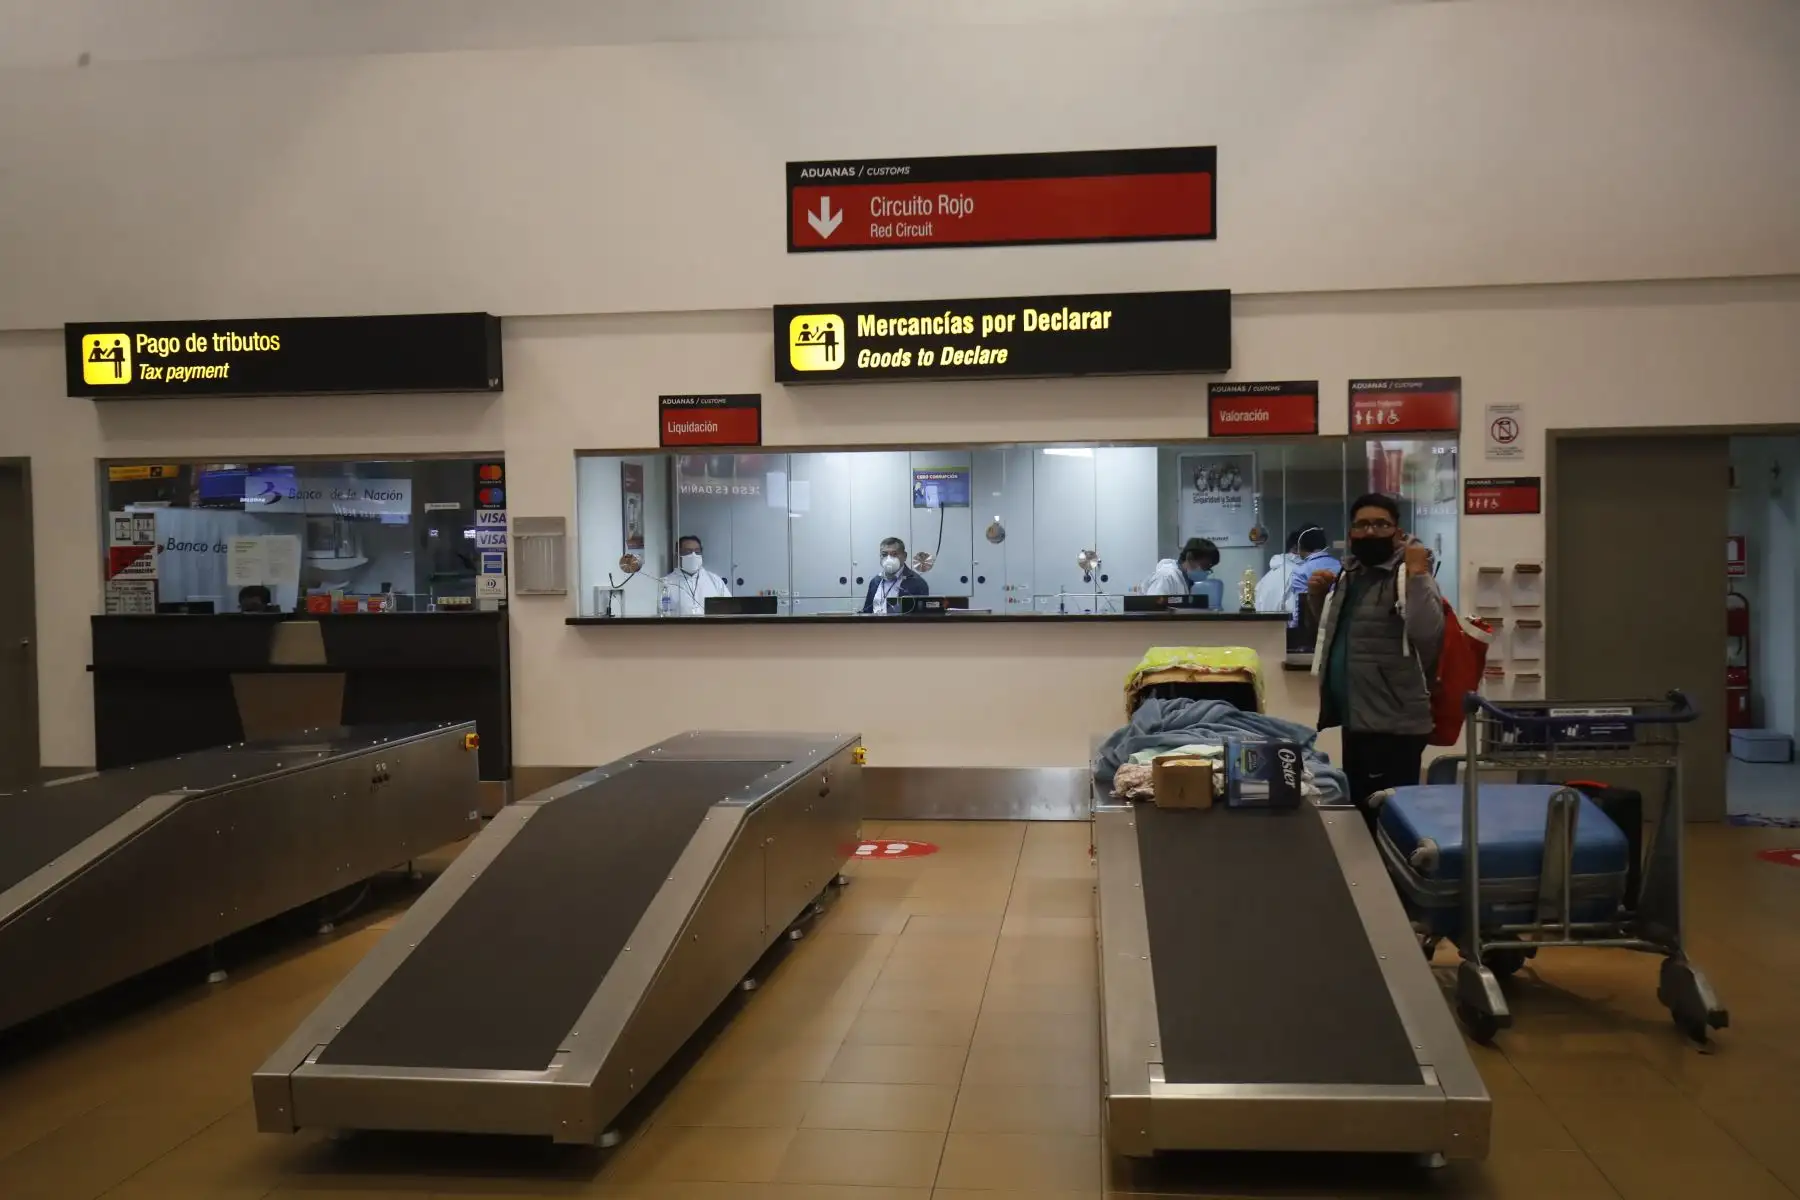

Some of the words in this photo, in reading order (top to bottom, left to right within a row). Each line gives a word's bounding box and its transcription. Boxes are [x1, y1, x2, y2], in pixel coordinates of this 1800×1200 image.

[800, 166, 856, 178] ADUANAS
[859, 165, 865, 177] /
[866, 165, 911, 177] CUSTOMS
[870, 195, 933, 218] Circuito
[938, 193, 975, 220] Rojo
[870, 222, 892, 238] Red
[896, 221, 933, 237] Circuit
[857, 310, 975, 338] Mercancías
[982, 314, 1016, 338] por
[1023, 307, 1112, 332] Declarar
[136, 333, 180, 357] Pago
[186, 332, 208, 353] de
[212, 331, 281, 353] tributos
[857, 349, 912, 369] Goods
[917, 347, 934, 368] to
[940, 345, 1009, 366] Declare
[139, 364, 163, 381] Tax
[166, 363, 230, 383] payment
[1211, 383, 1247, 393] ADUANAS
[1220, 408, 1269, 424] Valoración
[668, 420, 718, 435] Liquidación
[288, 488, 323, 500] Banco
[330, 487, 343, 499] de
[364, 487, 403, 501] Nación
[479, 512, 506, 524] VISA
[166, 537, 209, 553] Banco
[213, 537, 229, 554] de
[479, 534, 506, 545] VISA
[1277, 748, 1297, 789] Oster
